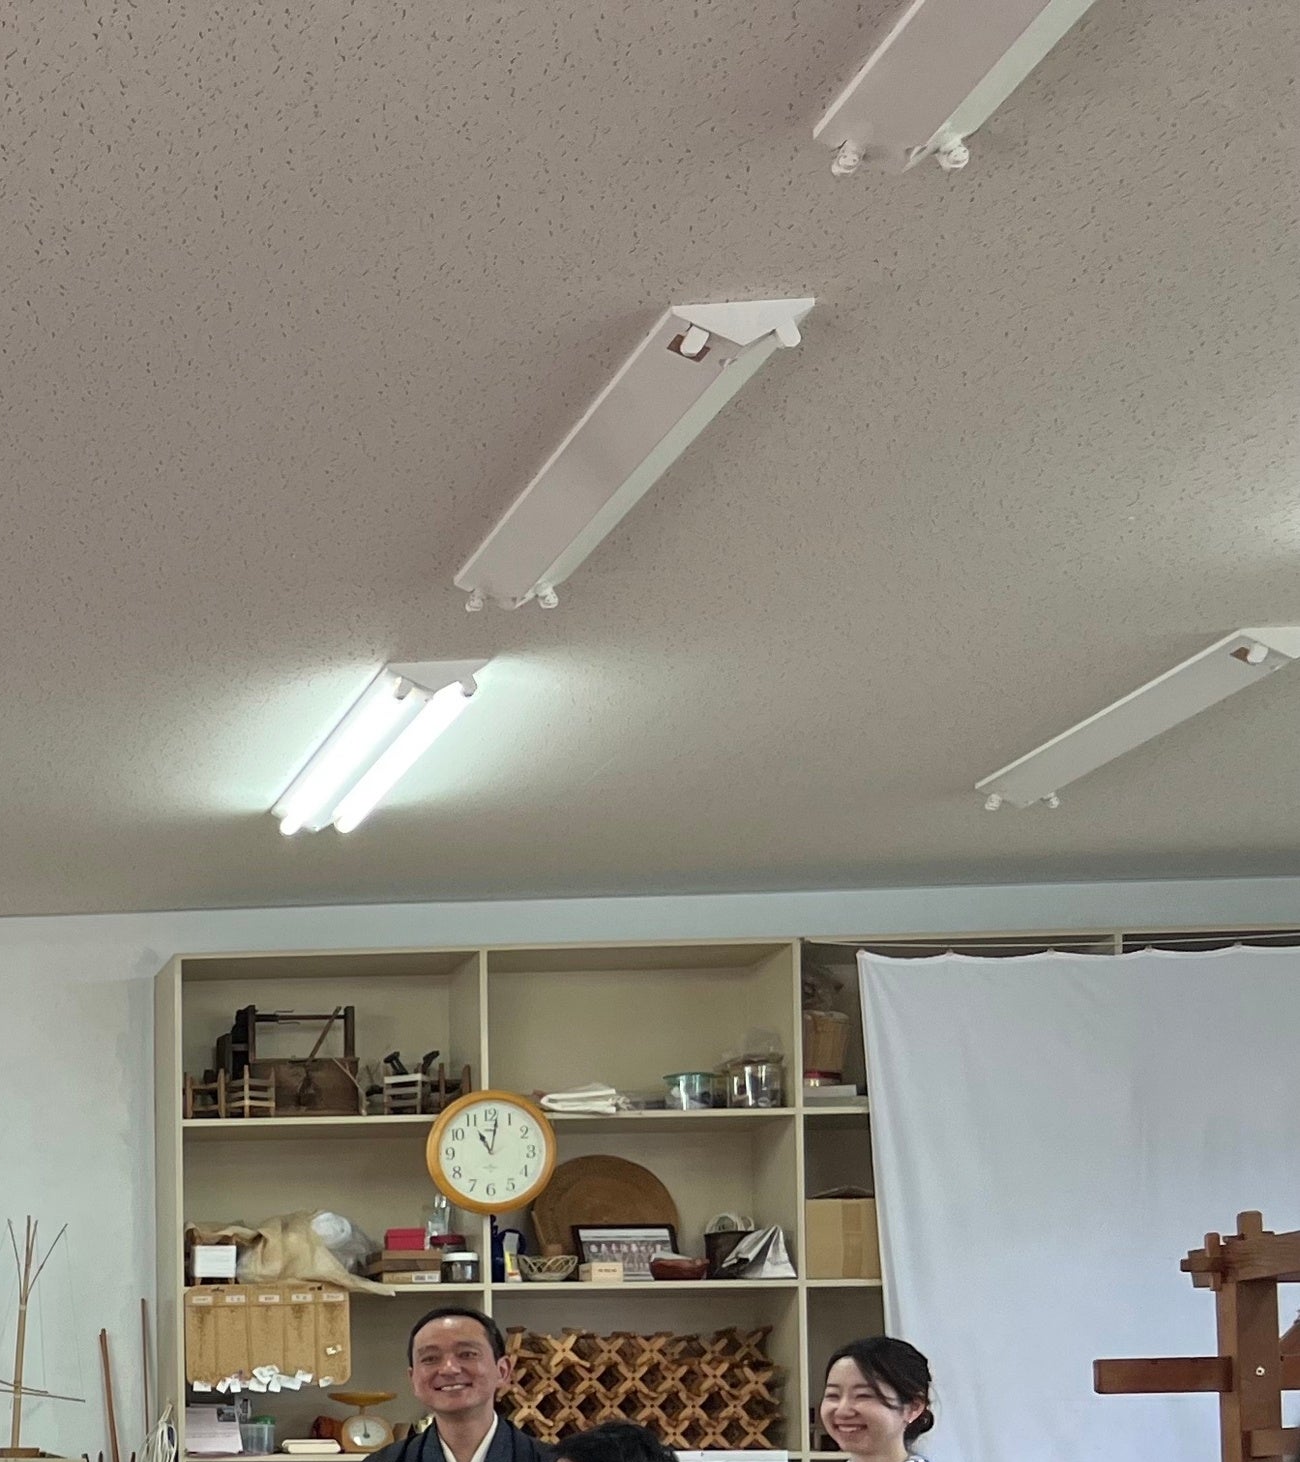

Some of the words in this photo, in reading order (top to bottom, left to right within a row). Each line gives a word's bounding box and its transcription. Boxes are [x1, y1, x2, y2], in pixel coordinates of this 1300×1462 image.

[466, 1114, 477, 1127] 11
[485, 1108, 497, 1121] 12
[508, 1113, 512, 1126] 1
[452, 1128, 464, 1141] 10
[520, 1126, 528, 1139] 2
[446, 1148, 455, 1160] 9
[526, 1145, 536, 1158] 3
[453, 1166, 462, 1179] 8
[521, 1165, 528, 1177] 4
[469, 1179, 477, 1192] 7
[486, 1183, 496, 1196] 6
[506, 1178, 515, 1191] 5
